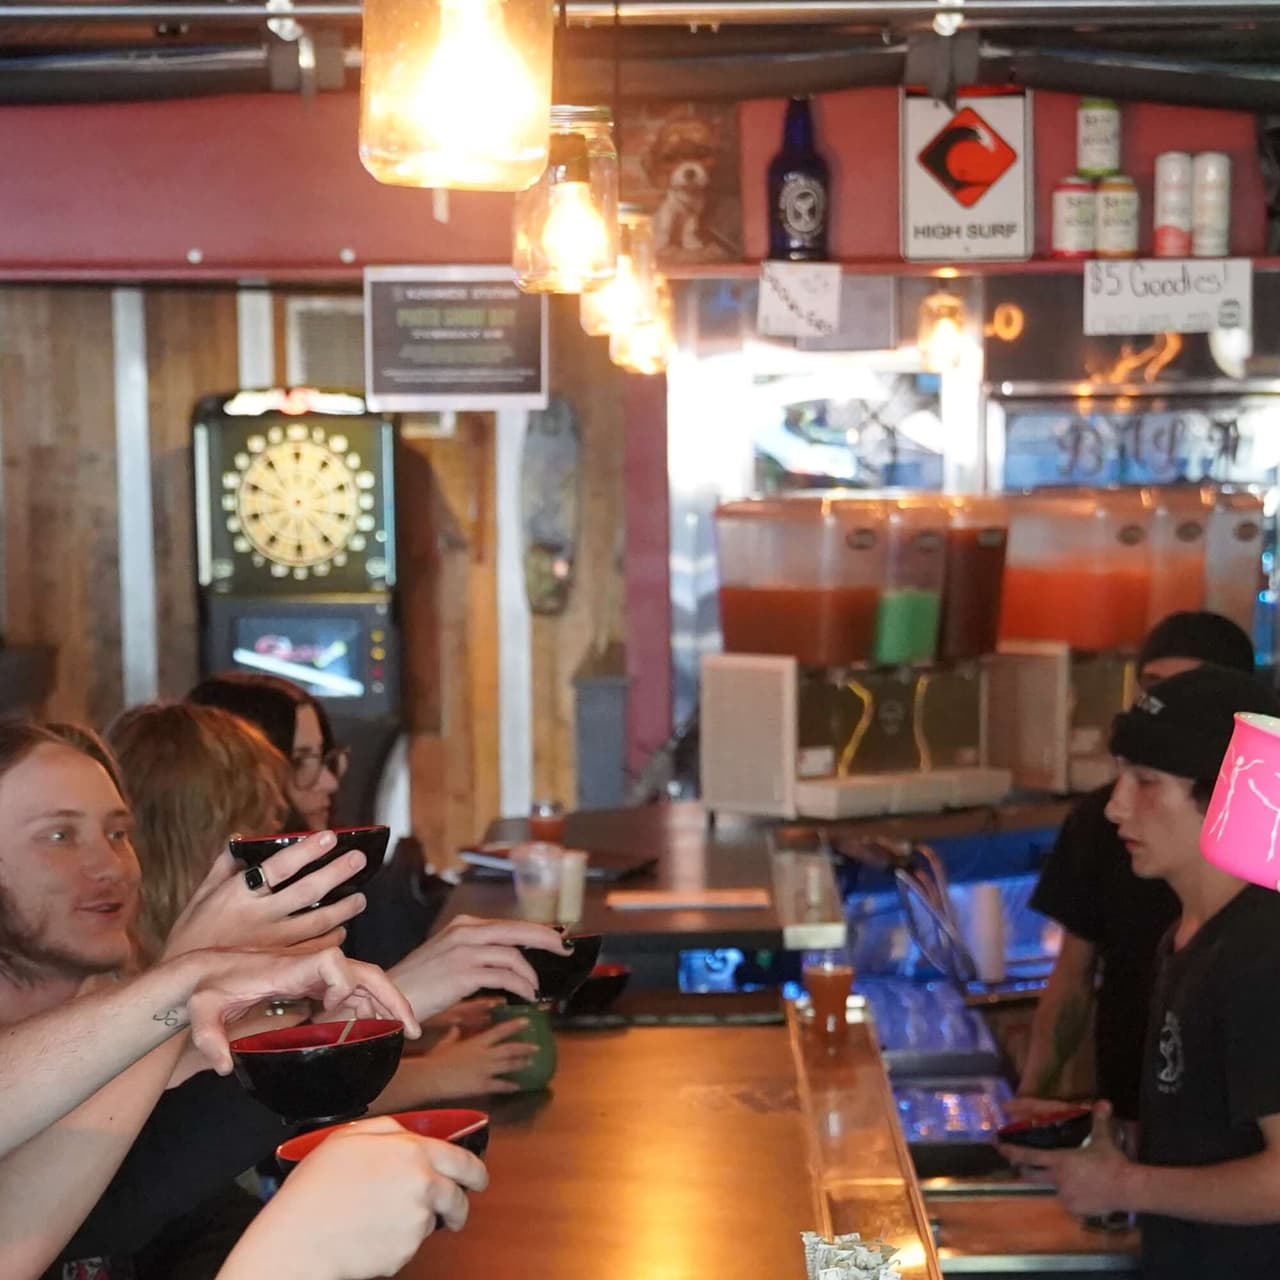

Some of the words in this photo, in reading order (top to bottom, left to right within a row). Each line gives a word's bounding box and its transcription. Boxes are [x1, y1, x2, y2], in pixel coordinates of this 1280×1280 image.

[913, 224, 960, 239] HIGH
[965, 223, 1018, 239] SURF
[1090, 259, 1120, 295] $5
